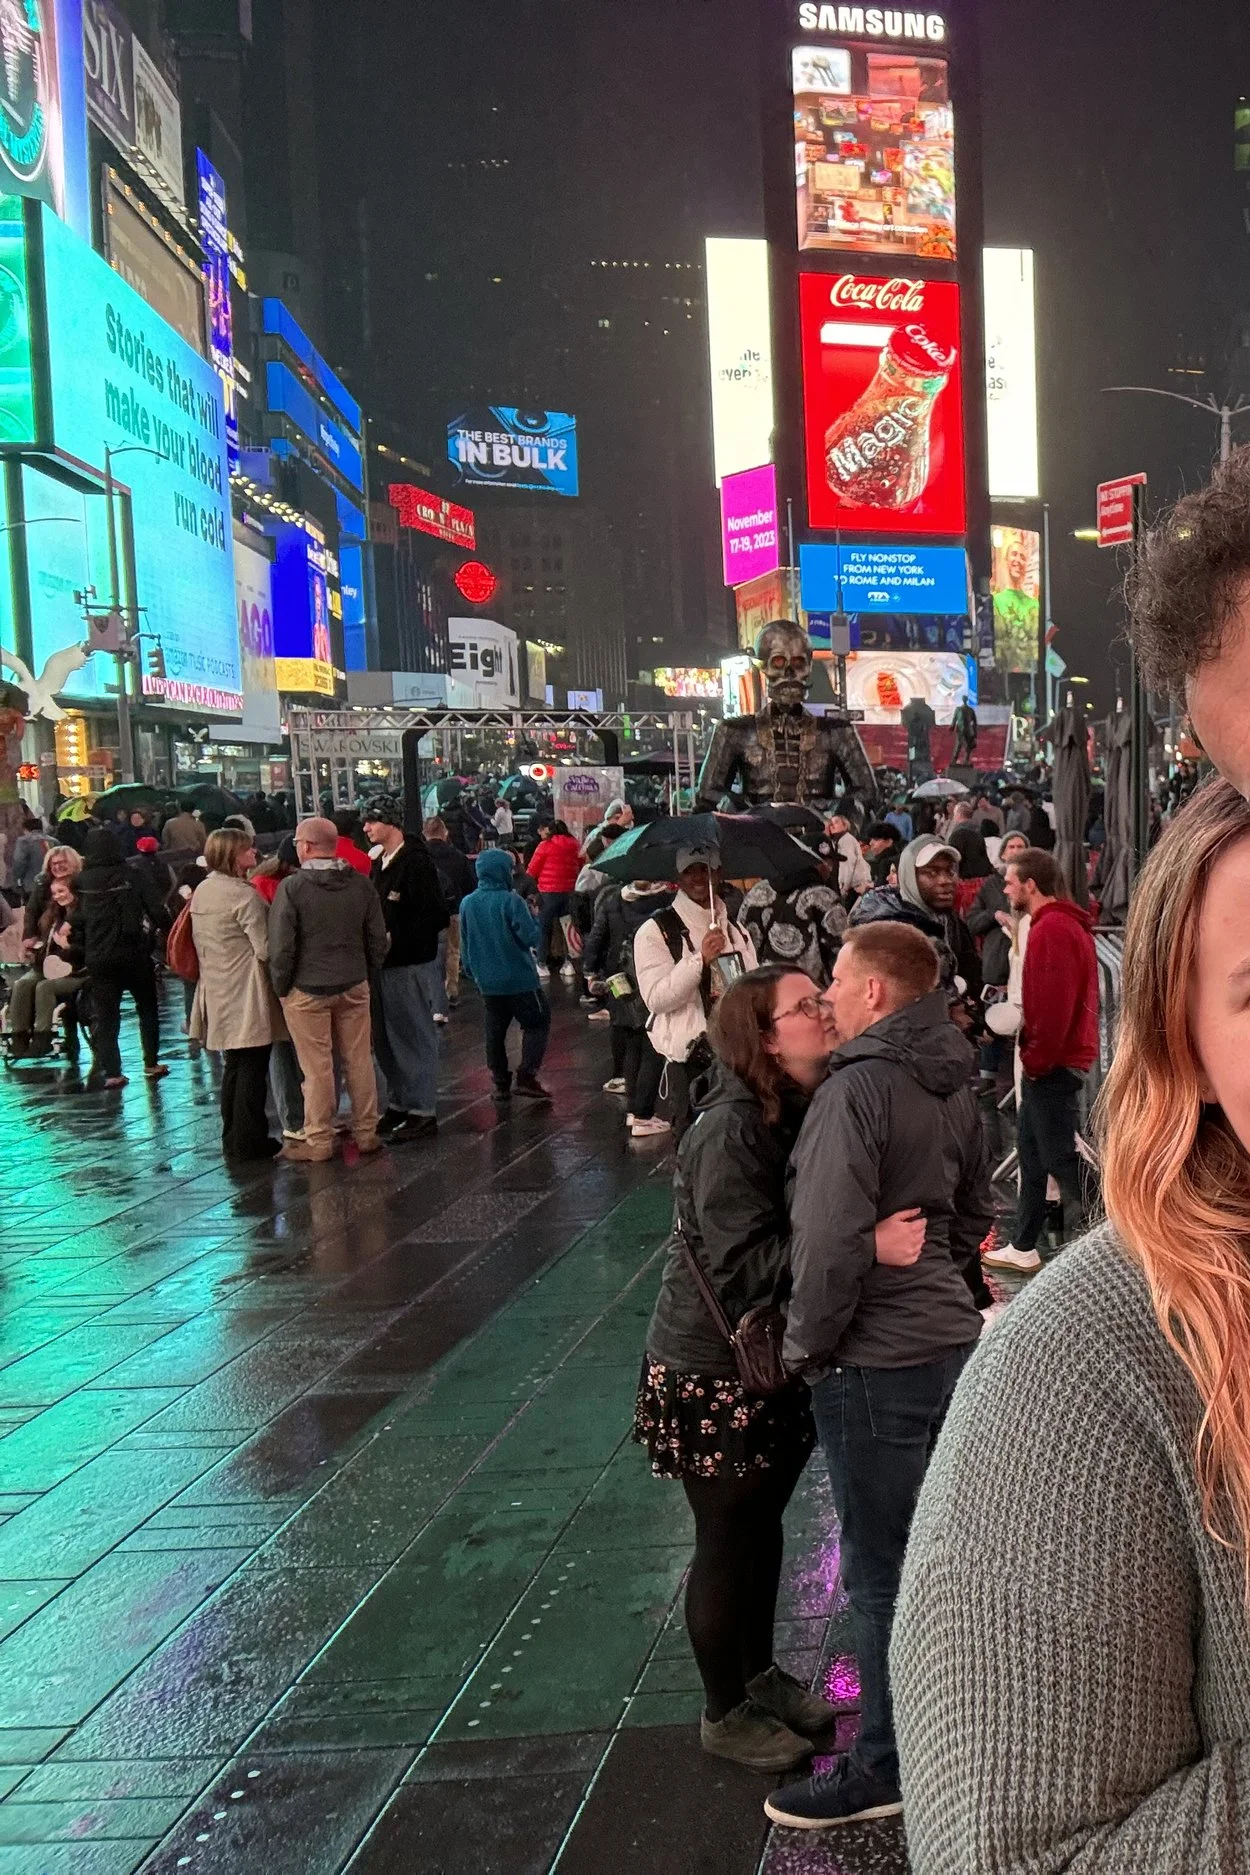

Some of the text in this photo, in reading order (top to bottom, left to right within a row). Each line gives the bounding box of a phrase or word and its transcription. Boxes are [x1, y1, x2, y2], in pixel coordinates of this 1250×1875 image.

[799, 4, 945, 40] SAMSUNG
[84, 0, 129, 121] SIX
[830, 274, 924, 312] Coca-Cola
[905, 323, 946, 366] Coke
[105, 303, 164, 394] Stories
[167, 357, 196, 420] that
[198, 391, 220, 439] will
[105, 378, 222, 496] make your blood
[457, 429, 567, 449] THE BEST BRANDS
[829, 397, 929, 482] Magic
[457, 441, 568, 471] IN BULK
[174, 491, 225, 551] run cold
[727, 511, 774, 532] November
[753, 530, 775, 550] 2023
[843, 564, 924, 575] FROM NEW YORK
[851, 553, 916, 564] FLY NONSTOP
[850, 576, 878, 585] ROME
[880, 577, 902, 585] AND
[903, 577, 935, 586] MILAN
